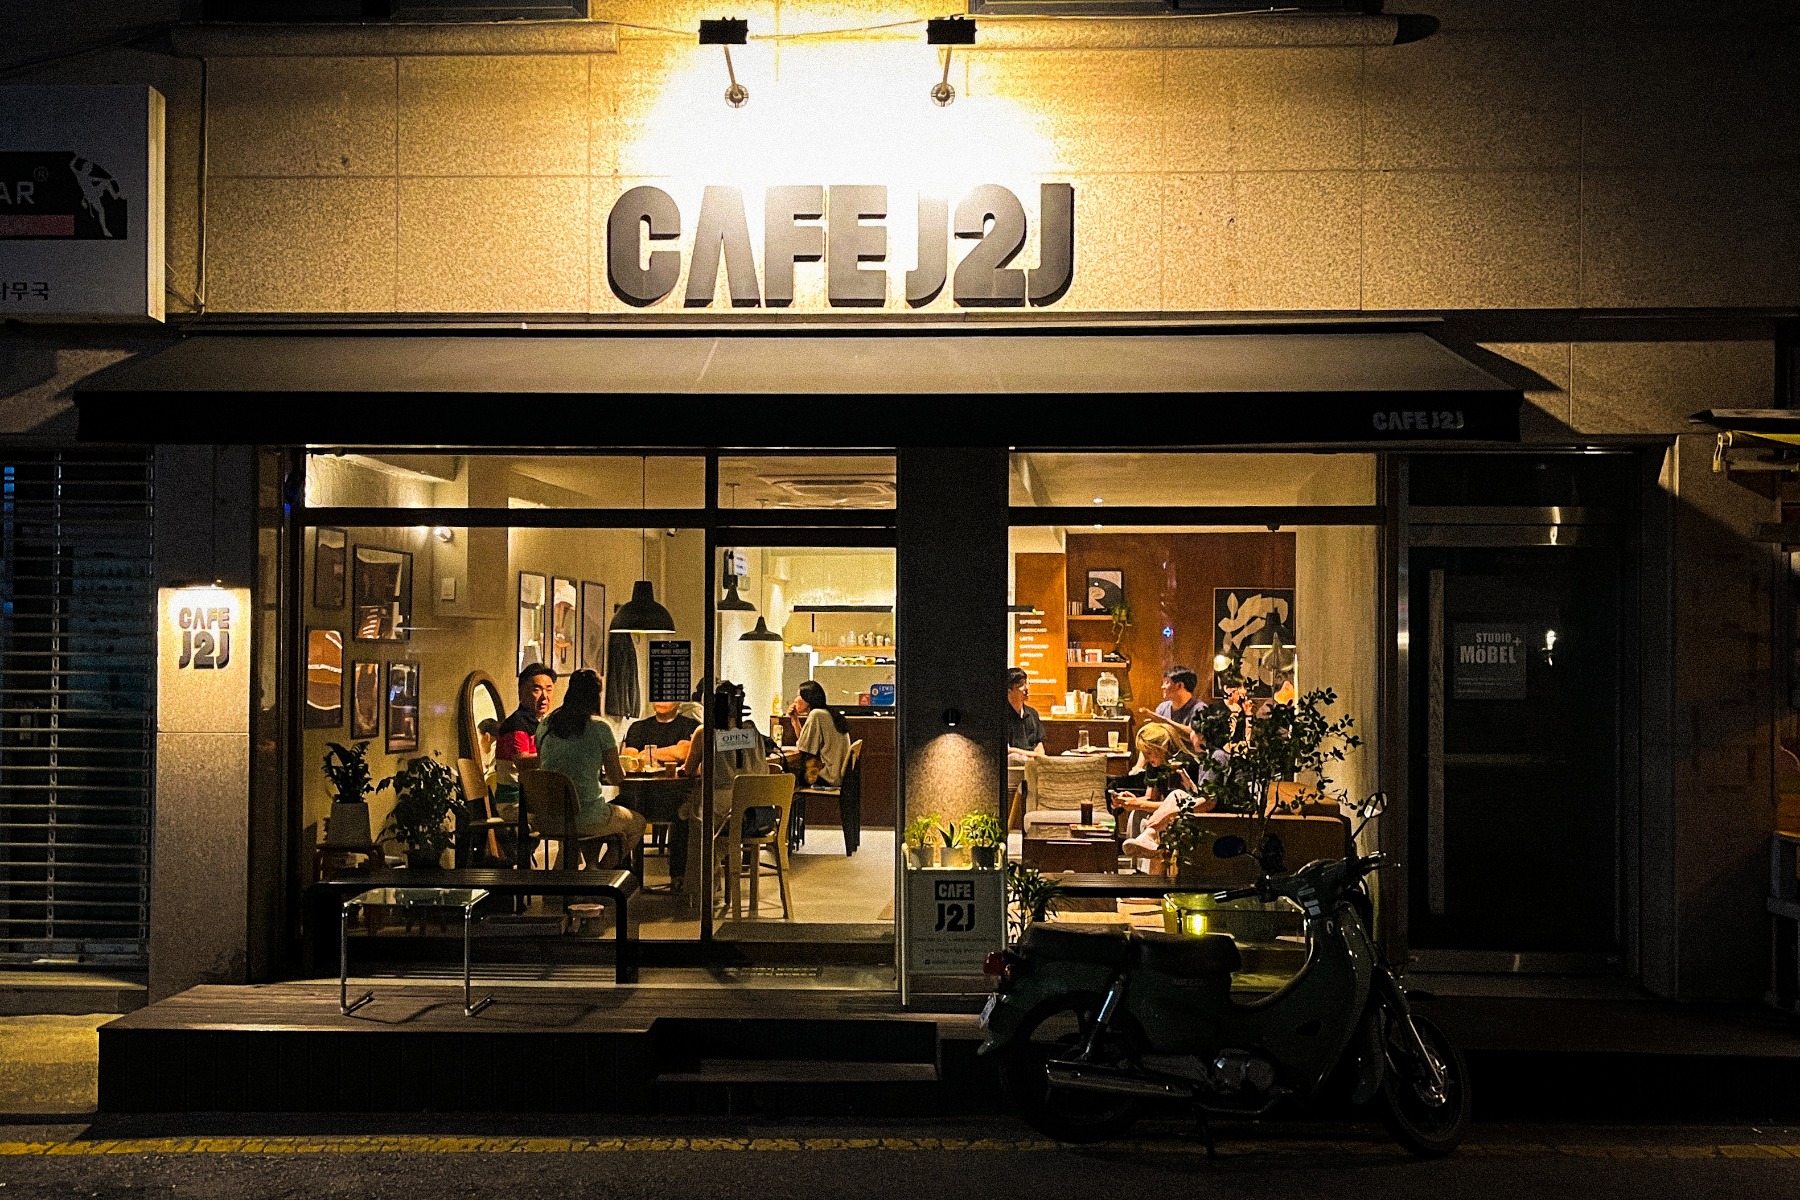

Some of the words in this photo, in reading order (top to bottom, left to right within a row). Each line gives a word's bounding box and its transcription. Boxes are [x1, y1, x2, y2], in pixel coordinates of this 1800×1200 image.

[606, 184, 888, 308] CAFE
[905, 182, 1075, 308] J2J
[1372, 411, 1429, 431] CAFE
[1431, 410, 1465, 430] J2J
[178, 607, 230, 630] CAFE
[1475, 632, 1512, 643] STUDIO
[178, 630, 230, 670] J2J
[722, 733, 749, 742] OPEN
[938, 883, 971, 898] CAFE
[935, 903, 976, 932] J2J
